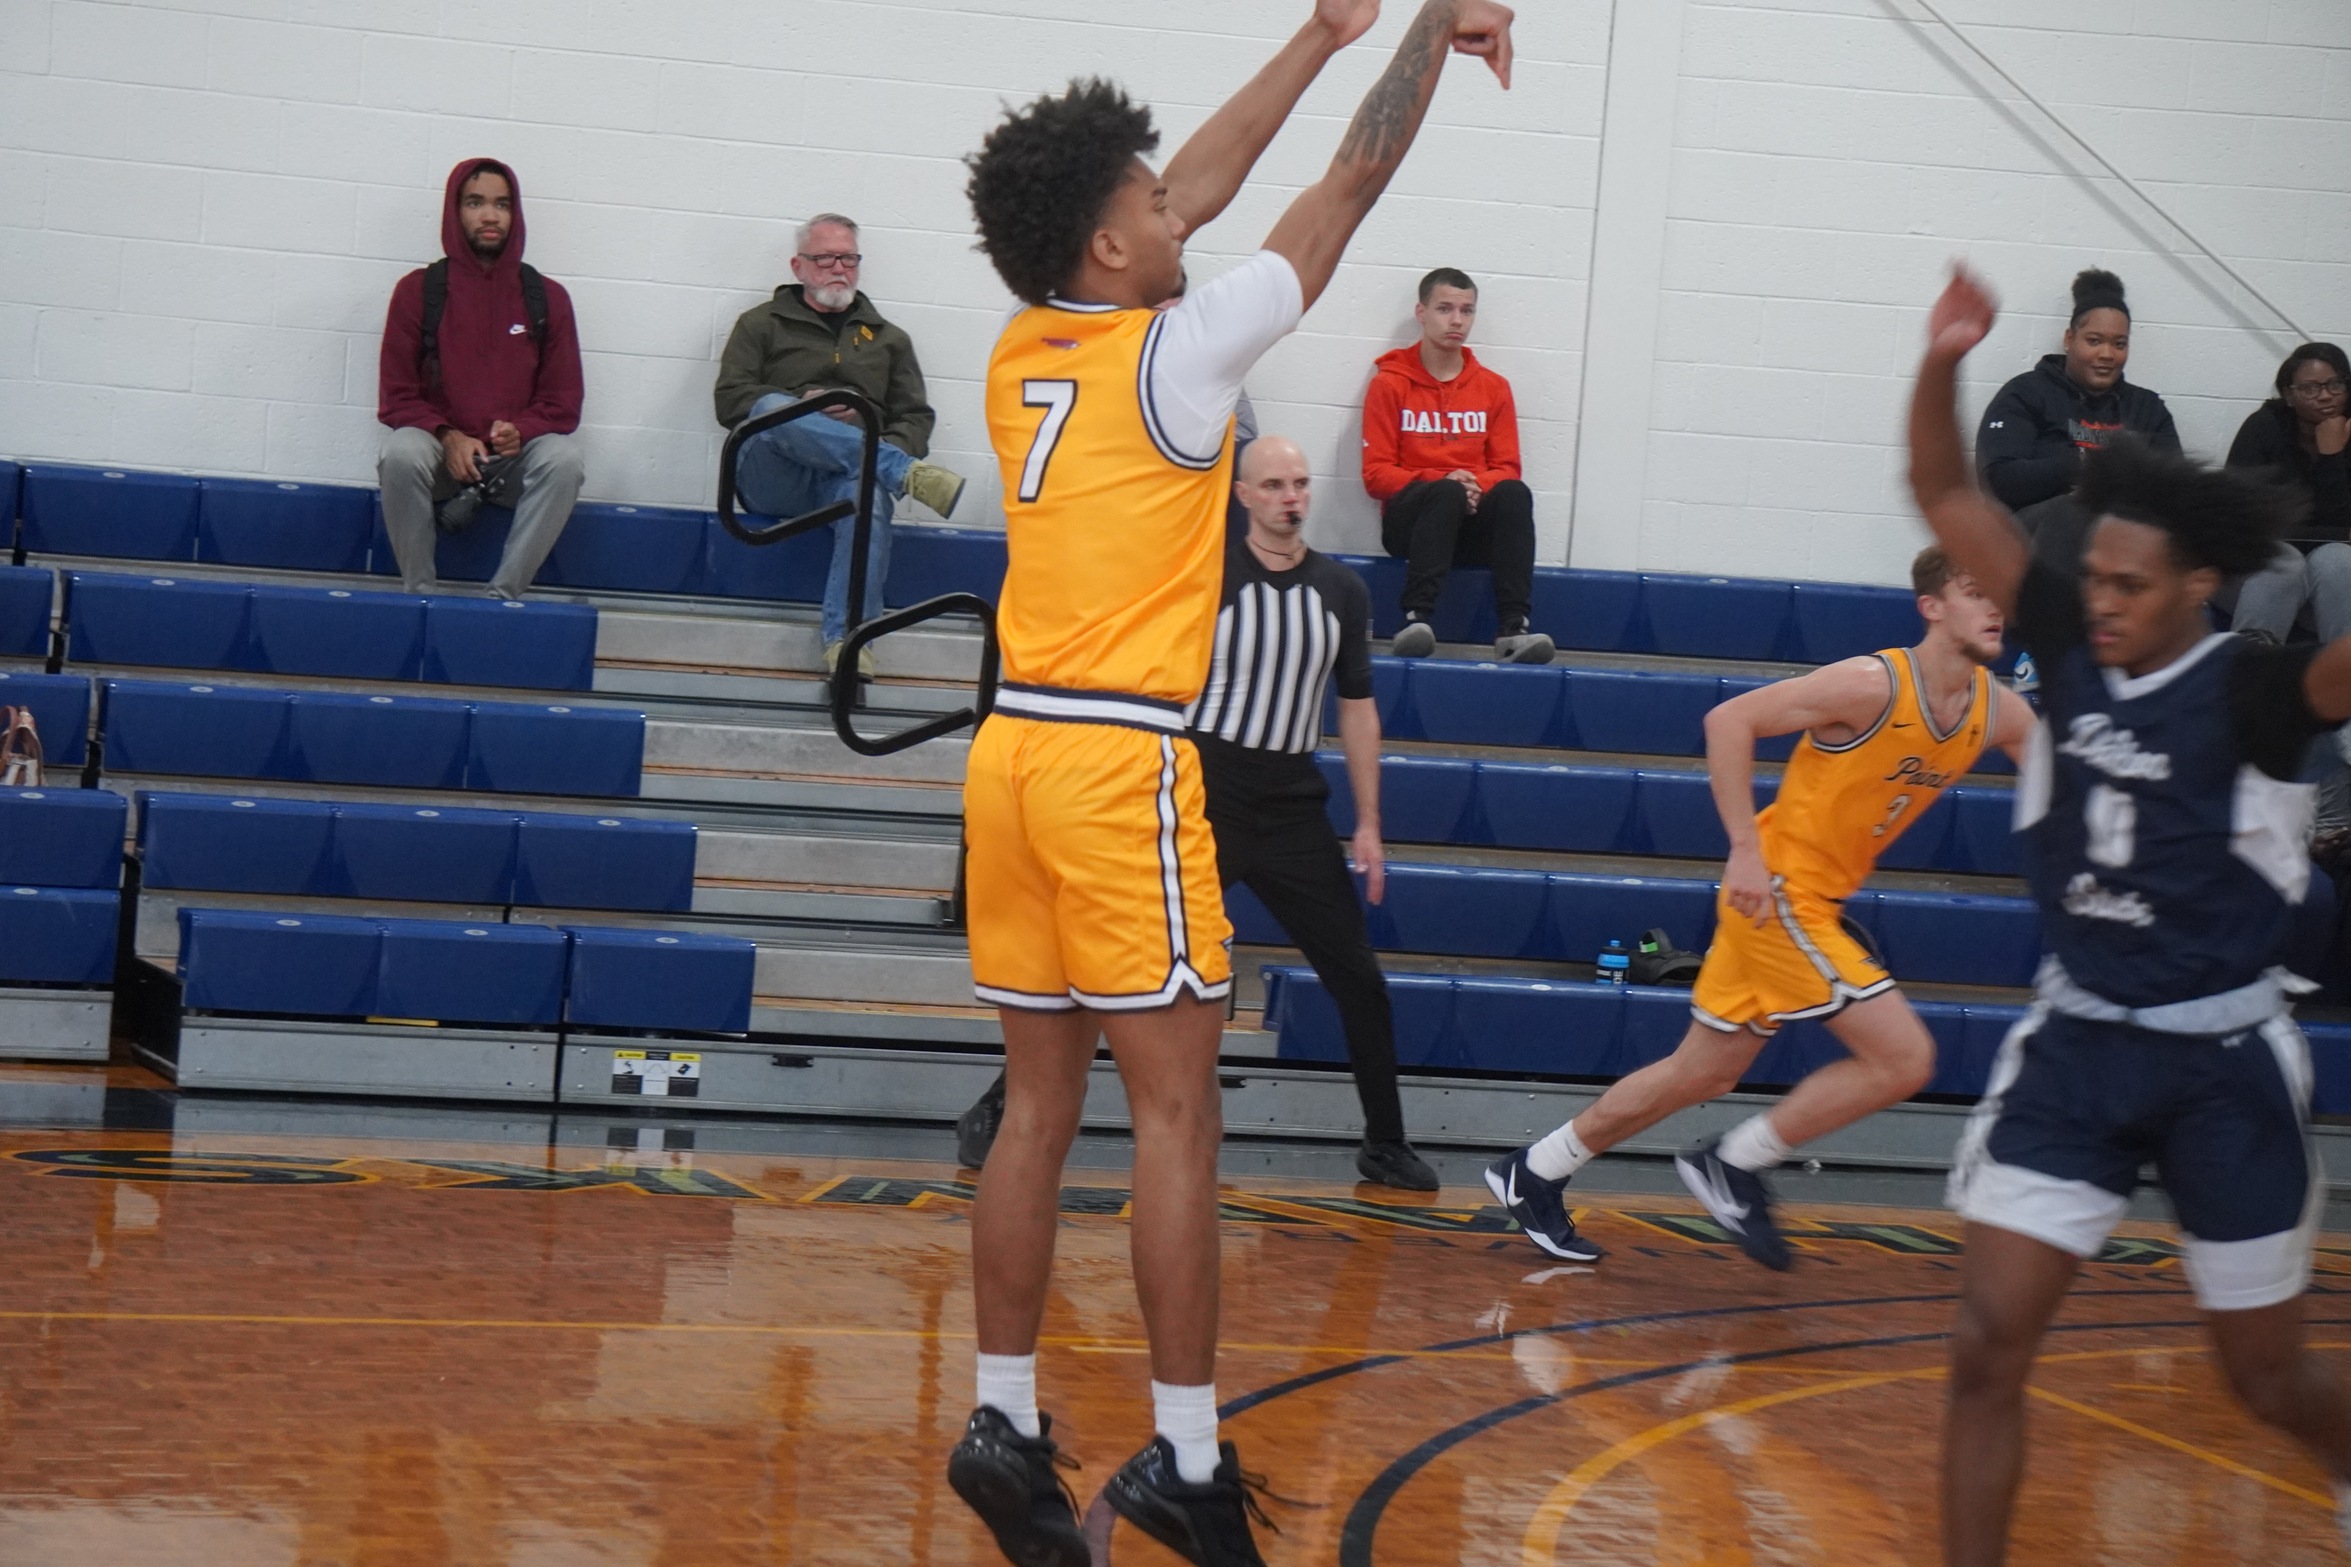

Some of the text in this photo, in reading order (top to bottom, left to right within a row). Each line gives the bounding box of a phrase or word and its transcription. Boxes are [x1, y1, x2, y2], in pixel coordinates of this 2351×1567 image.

[1018, 379, 1078, 502] 7
[1884, 757, 1953, 788] Point
[1872, 794, 1911, 836] 3
